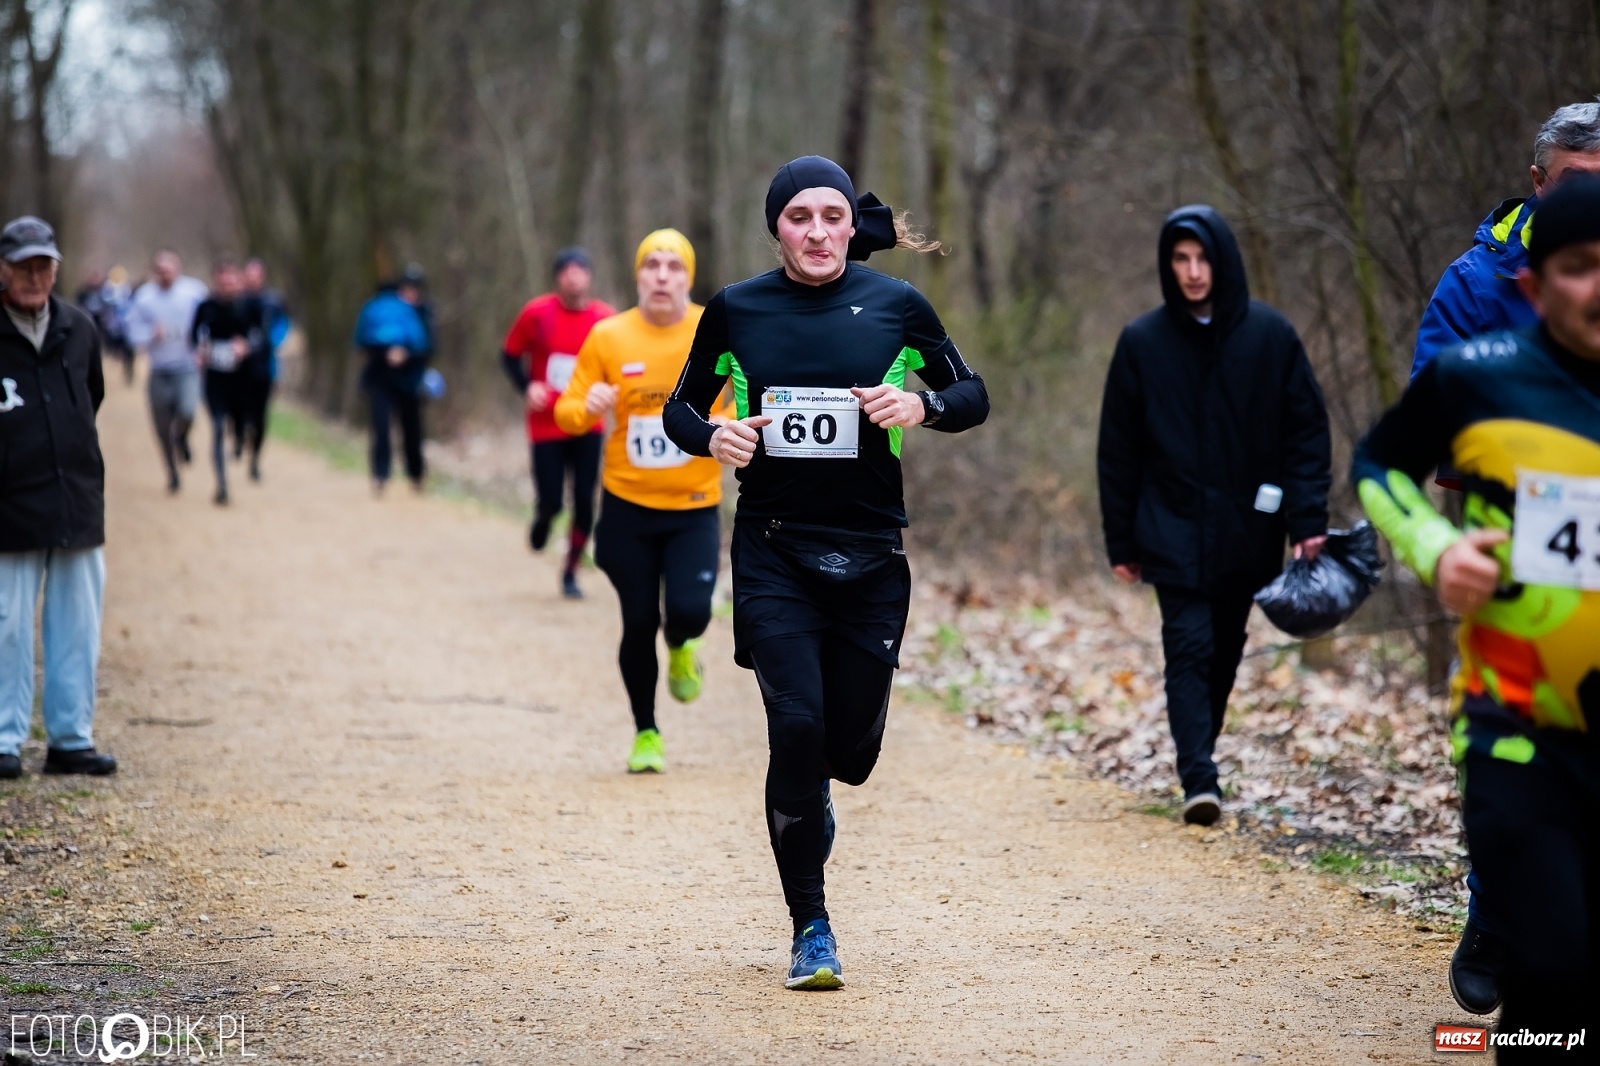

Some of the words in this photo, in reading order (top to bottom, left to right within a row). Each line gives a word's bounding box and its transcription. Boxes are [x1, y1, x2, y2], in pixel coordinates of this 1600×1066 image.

[796, 394, 856, 404] www.personalbest.pl
[782, 412, 838, 445] 60
[632, 436, 681, 458] 19
[1547, 519, 1600, 564] 4
[819, 565, 847, 575] umbro
